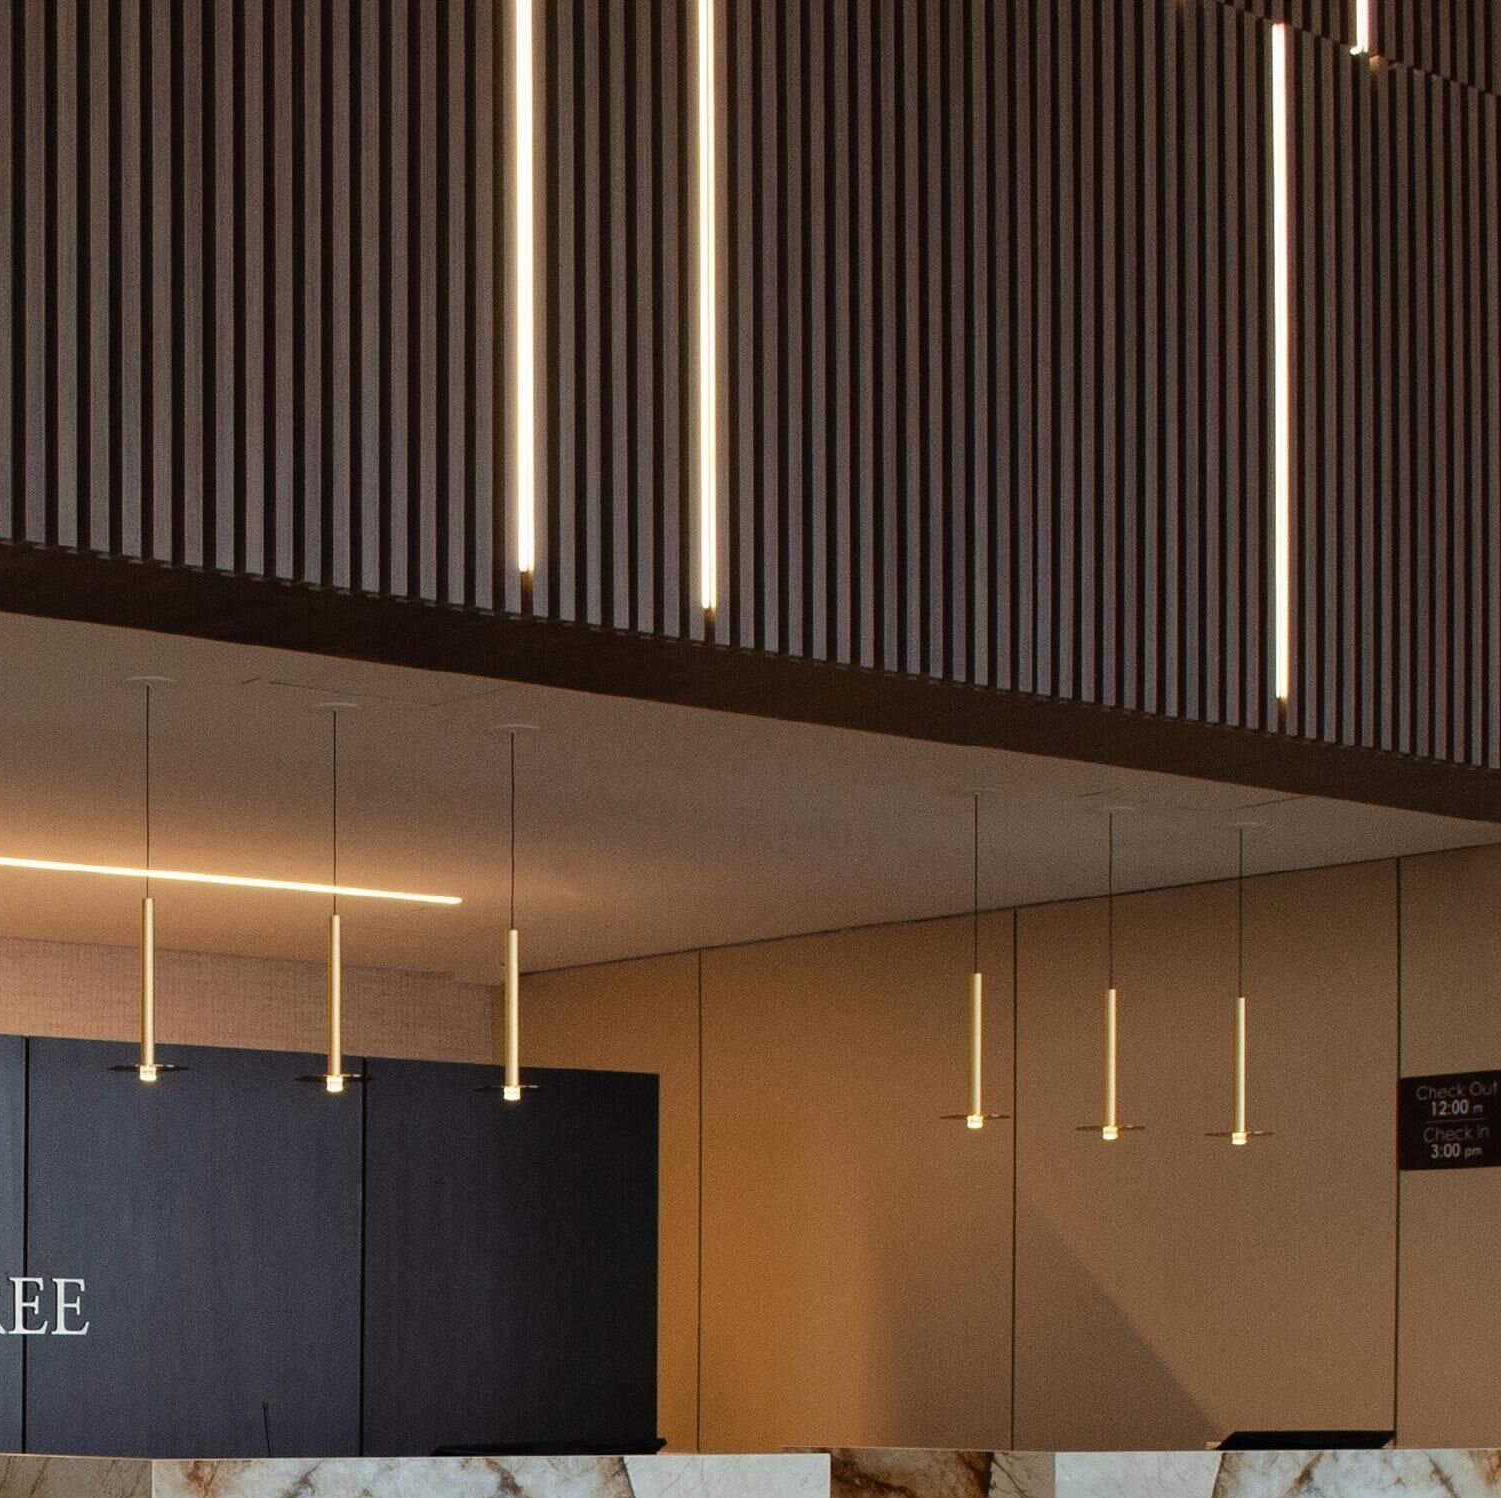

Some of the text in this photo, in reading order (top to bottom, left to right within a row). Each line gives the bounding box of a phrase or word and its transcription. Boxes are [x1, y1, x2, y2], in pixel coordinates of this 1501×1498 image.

[1416, 1081, 1498, 1101] Check Out
[1431, 1099, 1469, 1117] 12:00
[1423, 1124, 1490, 1143] Check In
[1430, 1143, 1483, 1160] 3:00 pm
